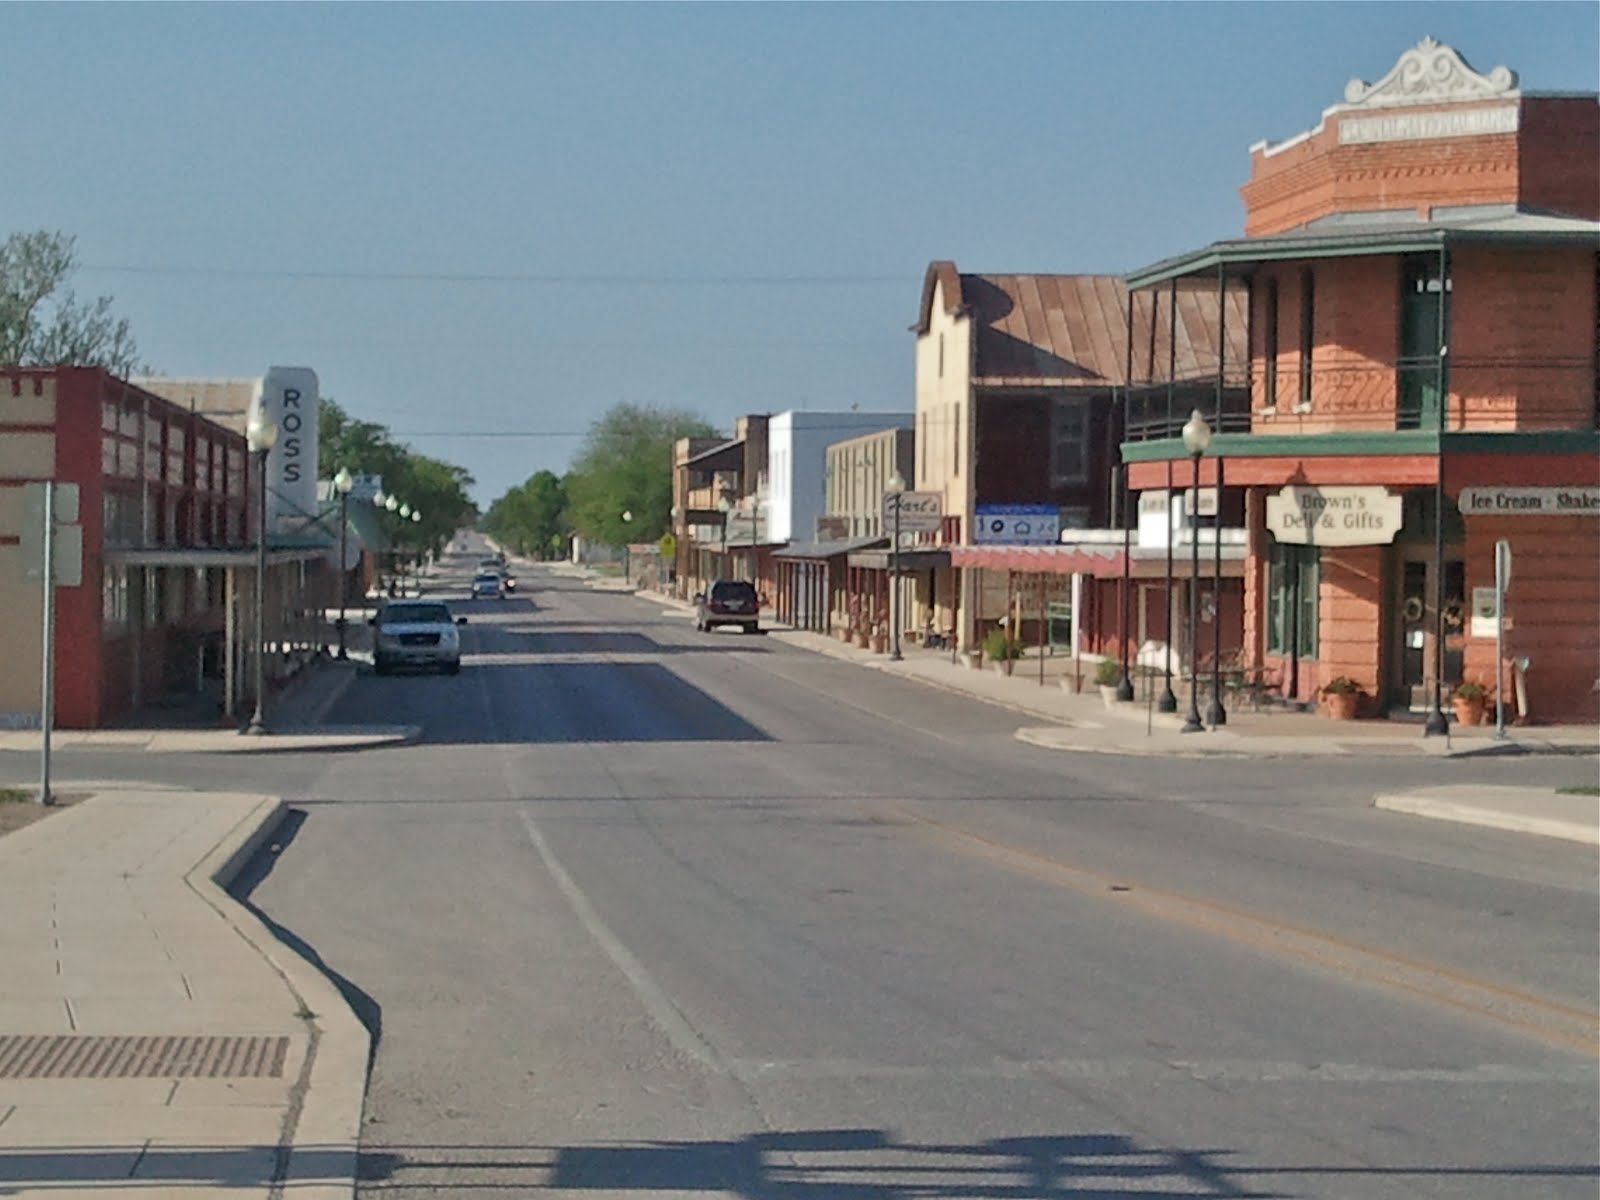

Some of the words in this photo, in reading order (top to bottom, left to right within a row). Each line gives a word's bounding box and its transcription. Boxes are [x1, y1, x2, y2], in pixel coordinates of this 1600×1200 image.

[283, 388, 302, 482] ROSS
[1302, 494, 1367, 510] Brown's
[1471, 493, 1493, 509] Ice
[1496, 493, 1542, 509] Cream
[1283, 510, 1314, 528] Deli
[1321, 513, 1336, 528] &
[1343, 511, 1384, 529] Gifts
